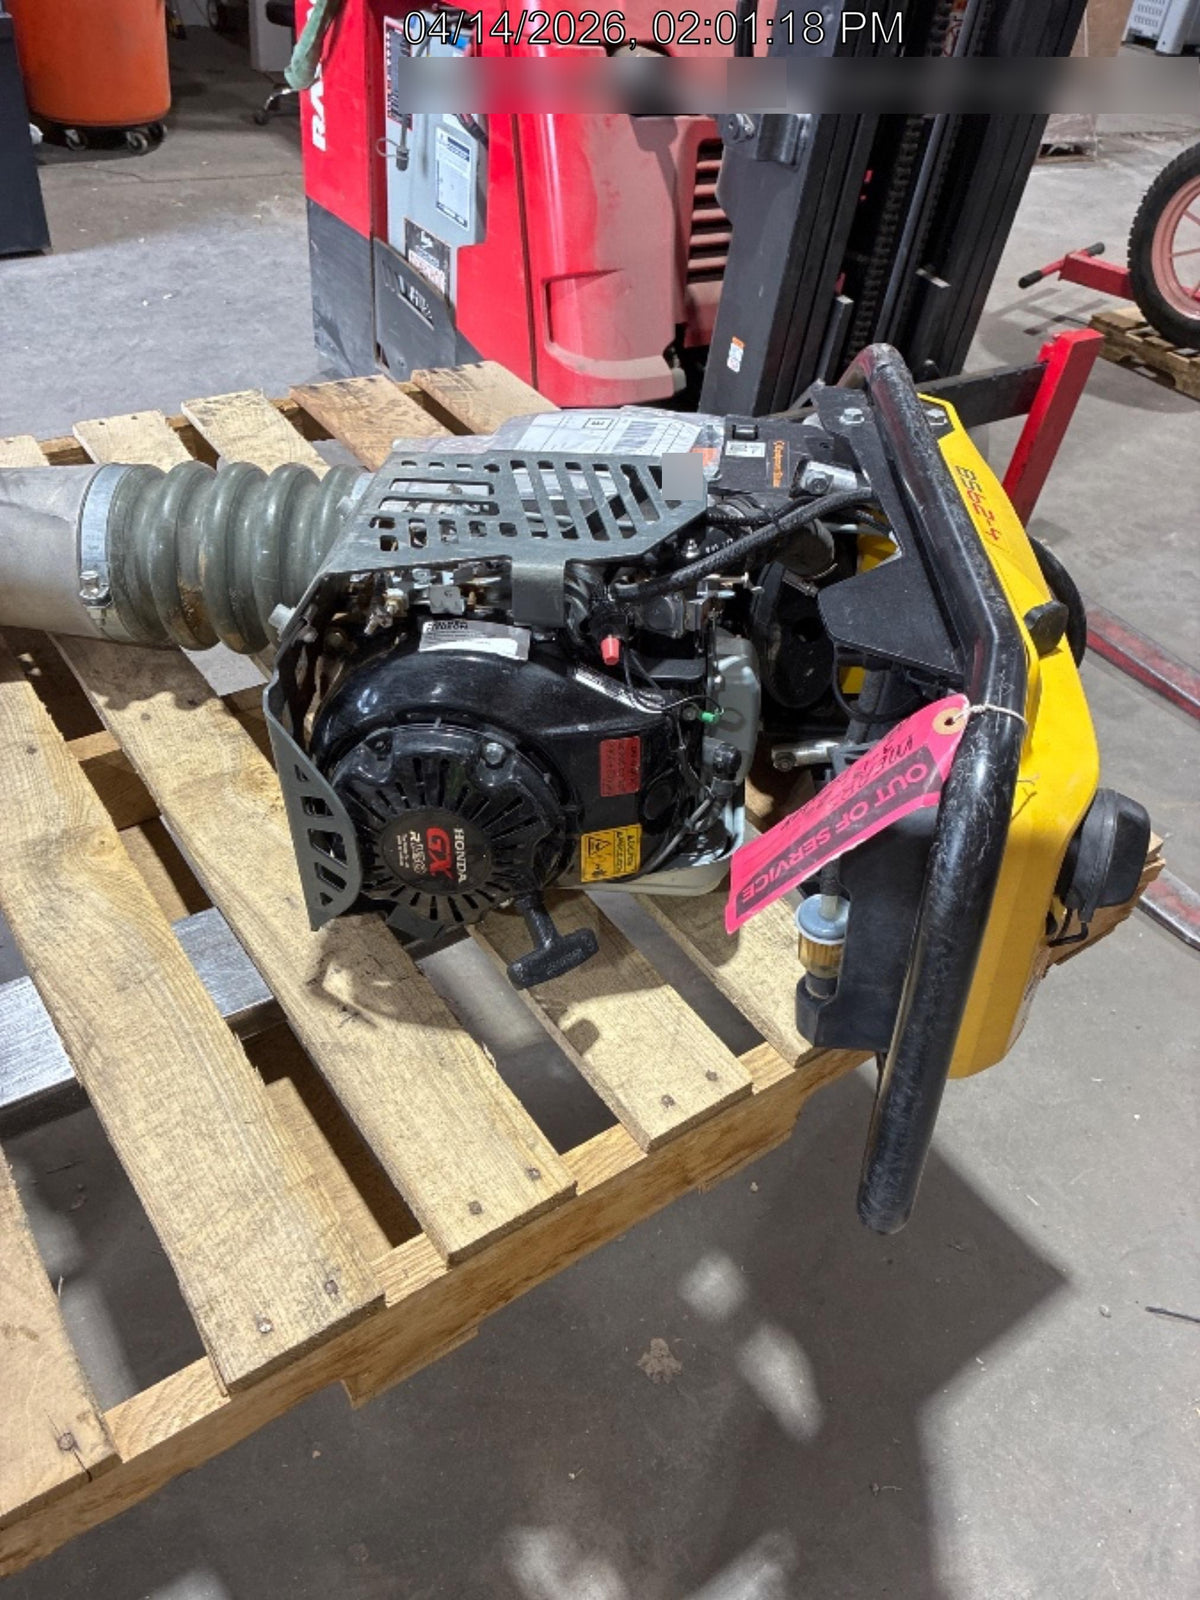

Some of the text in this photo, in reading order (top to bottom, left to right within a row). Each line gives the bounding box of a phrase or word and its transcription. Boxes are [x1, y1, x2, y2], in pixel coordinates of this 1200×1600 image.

[872, 763, 929, 809] OUT
[836, 800, 868, 834] OF
[426, 826, 455, 881] GX
[454, 827, 468, 884] HONDA
[742, 828, 832, 903] SERVICE
